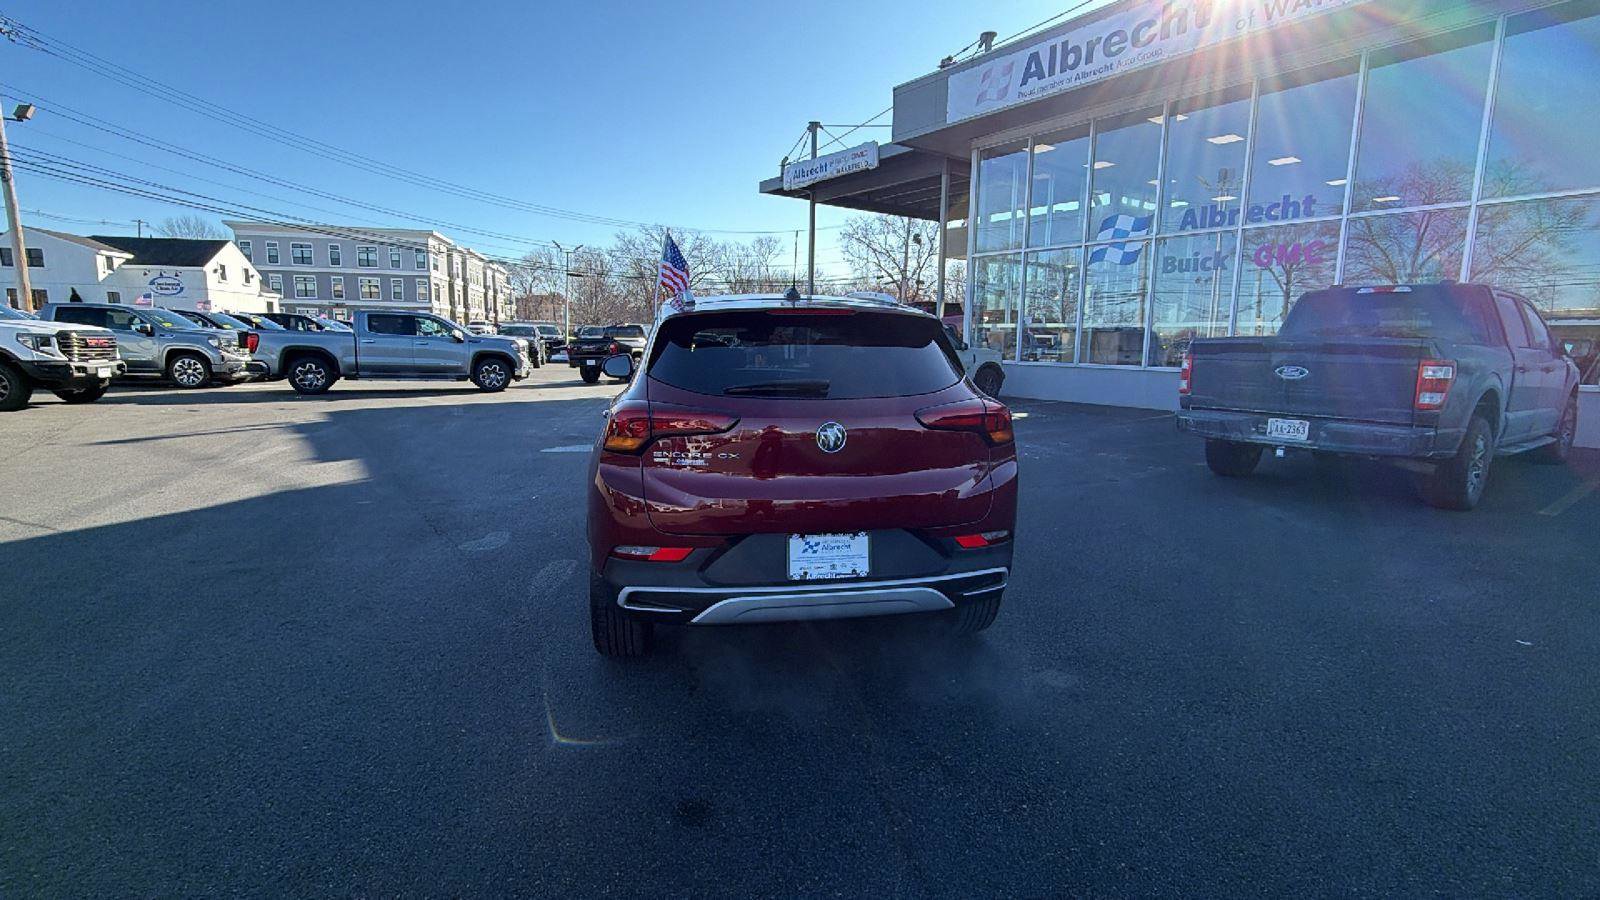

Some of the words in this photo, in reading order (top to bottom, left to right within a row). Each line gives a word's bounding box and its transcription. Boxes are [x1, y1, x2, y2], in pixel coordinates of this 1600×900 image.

[1020, 0, 1211, 87] Albrecht
[1235, 8, 1255, 30] of
[1037, 79, 1065, 95] member
[1074, 62, 1114, 82] Albrecht
[1137, 47, 1163, 62] Group
[793, 162, 827, 180] Albrecht
[1180, 194, 1318, 231] Albrecht
[1162, 251, 1228, 275] Buick
[1253, 240, 1328, 268] GMC
[653, 451, 713, 459] ENCORE
[821, 543, 851, 551] Albrecht
